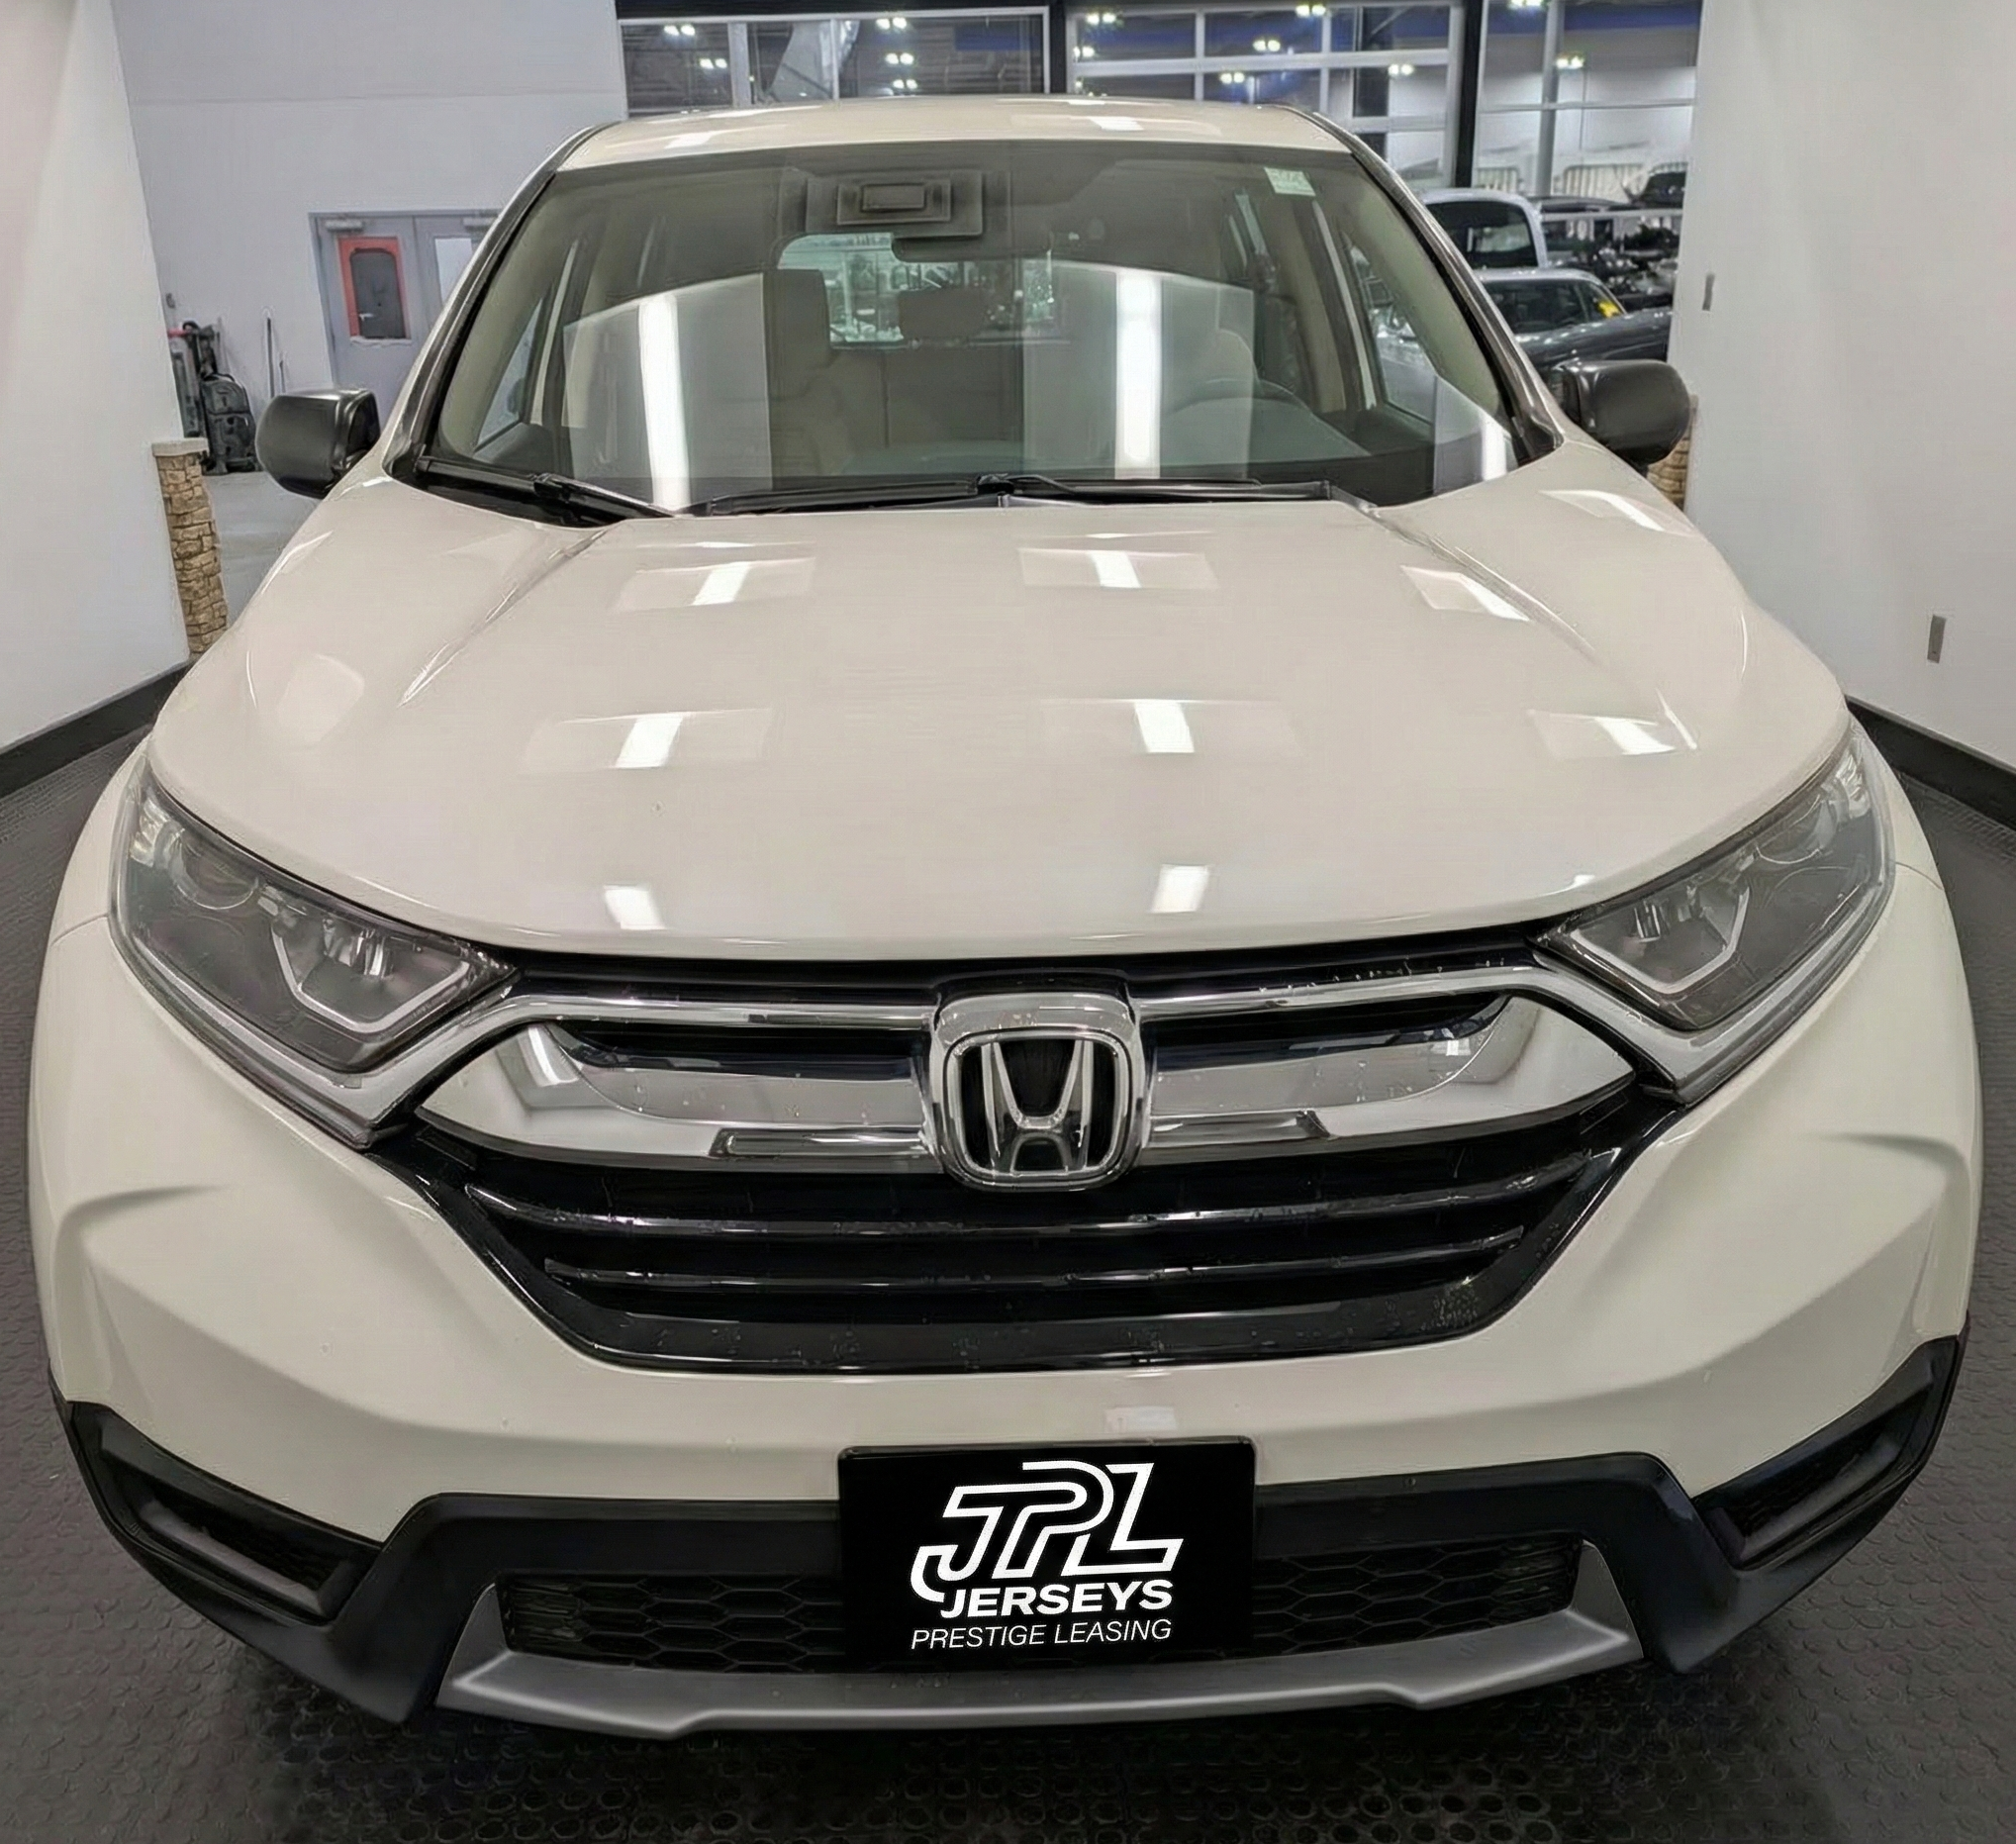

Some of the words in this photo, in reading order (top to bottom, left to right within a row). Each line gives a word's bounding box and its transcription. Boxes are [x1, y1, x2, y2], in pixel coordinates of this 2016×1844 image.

[910, 1459, 1185, 1602] JPL
[939, 1579, 1174, 1619] JERSEYS
[911, 1624, 1047, 1650] PRESTIGE
[1054, 1618, 1172, 1644] LEASING
